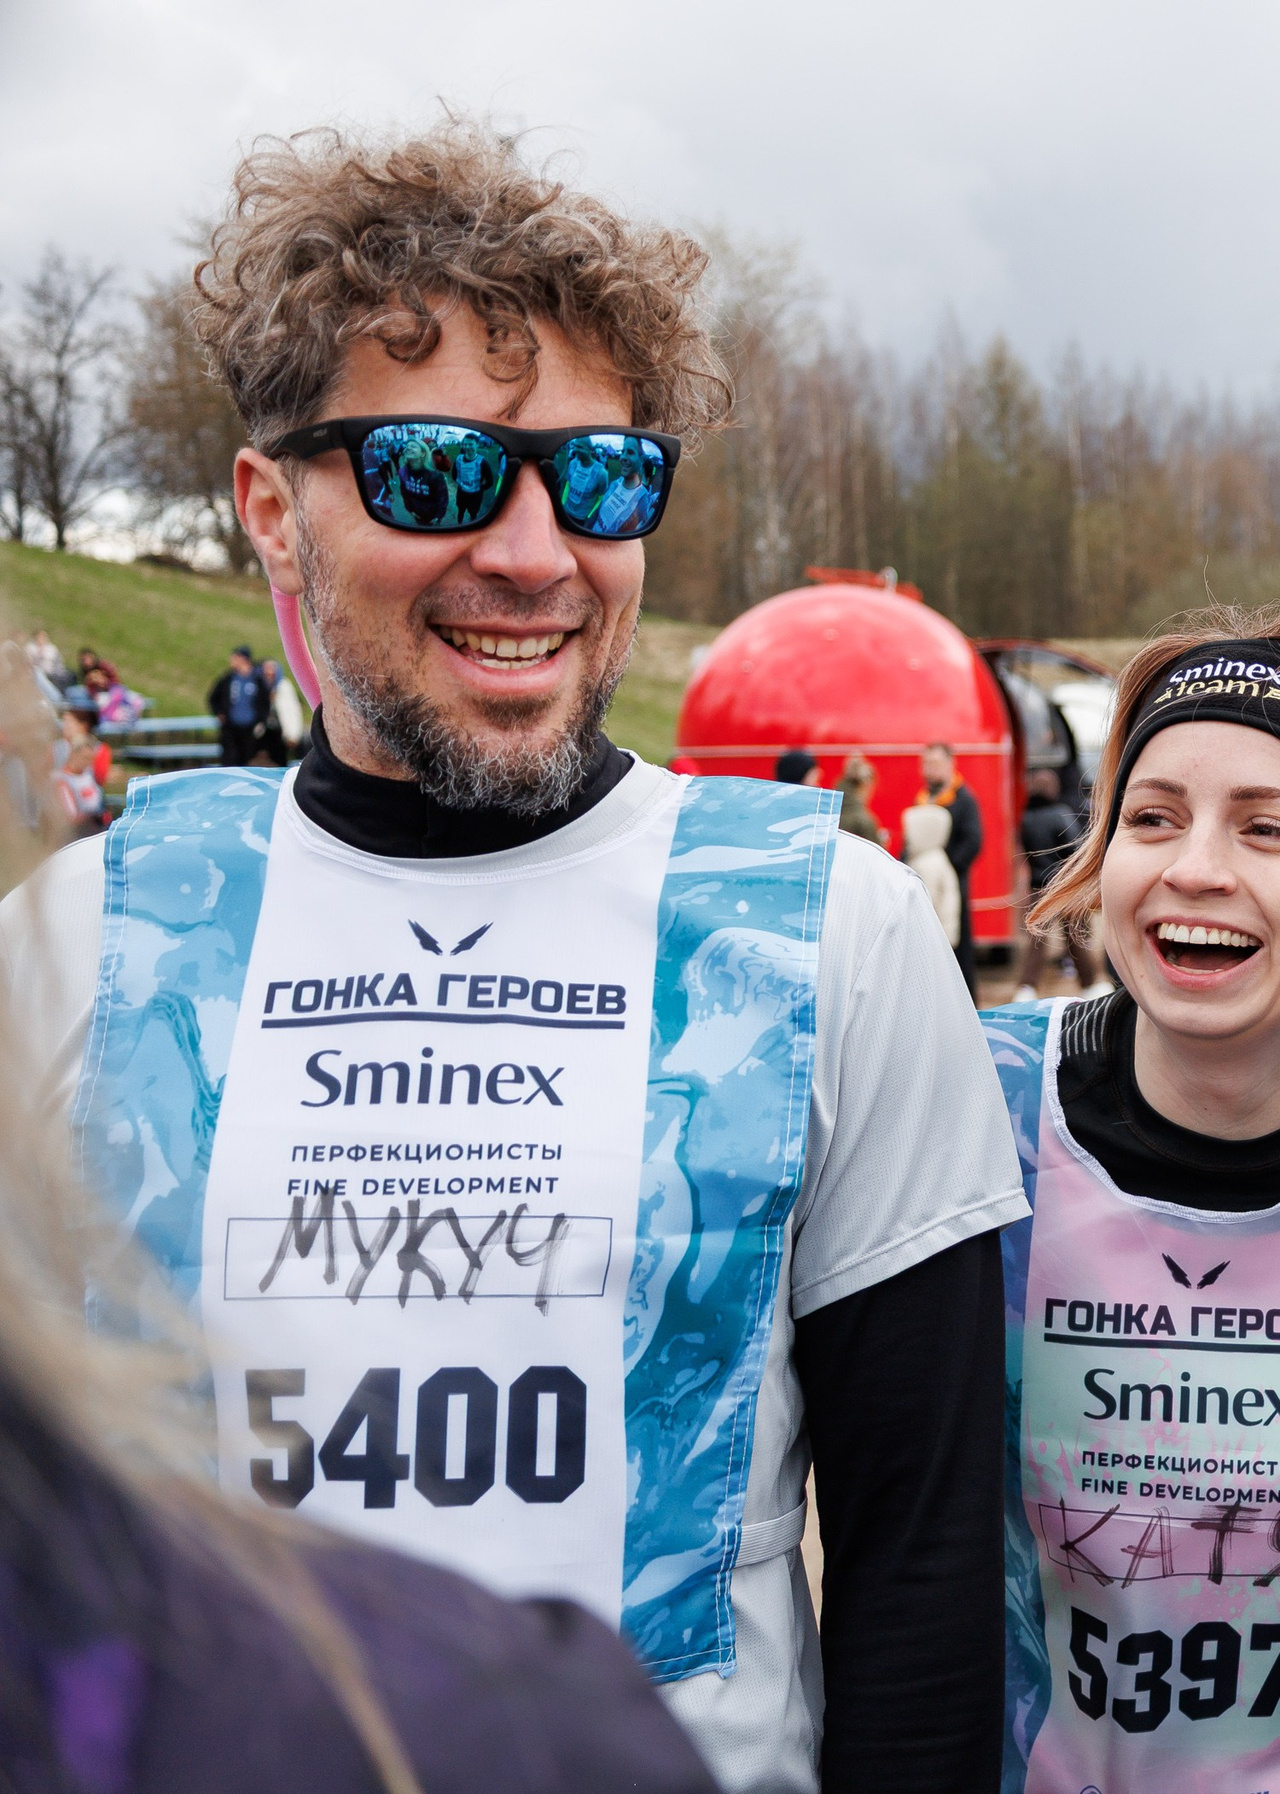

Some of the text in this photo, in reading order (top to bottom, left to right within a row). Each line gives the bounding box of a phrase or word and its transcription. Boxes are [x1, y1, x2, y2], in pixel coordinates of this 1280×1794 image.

[1176, 679, 1260, 697] team
[263, 972, 627, 1015] ГОНКА ГЕРОЕВ
[301, 1046, 565, 1108] Sminex
[292, 1142, 562, 1164] ПЕРФЕКЦИОНИСТЫ
[287, 1176, 559, 1197] FINE DEVELOPMENT
[1044, 1297, 1176, 1336] ГОНКА
[245, 1366, 587, 1510] 5400
[1082, 1478, 1128, 1496] FINE
